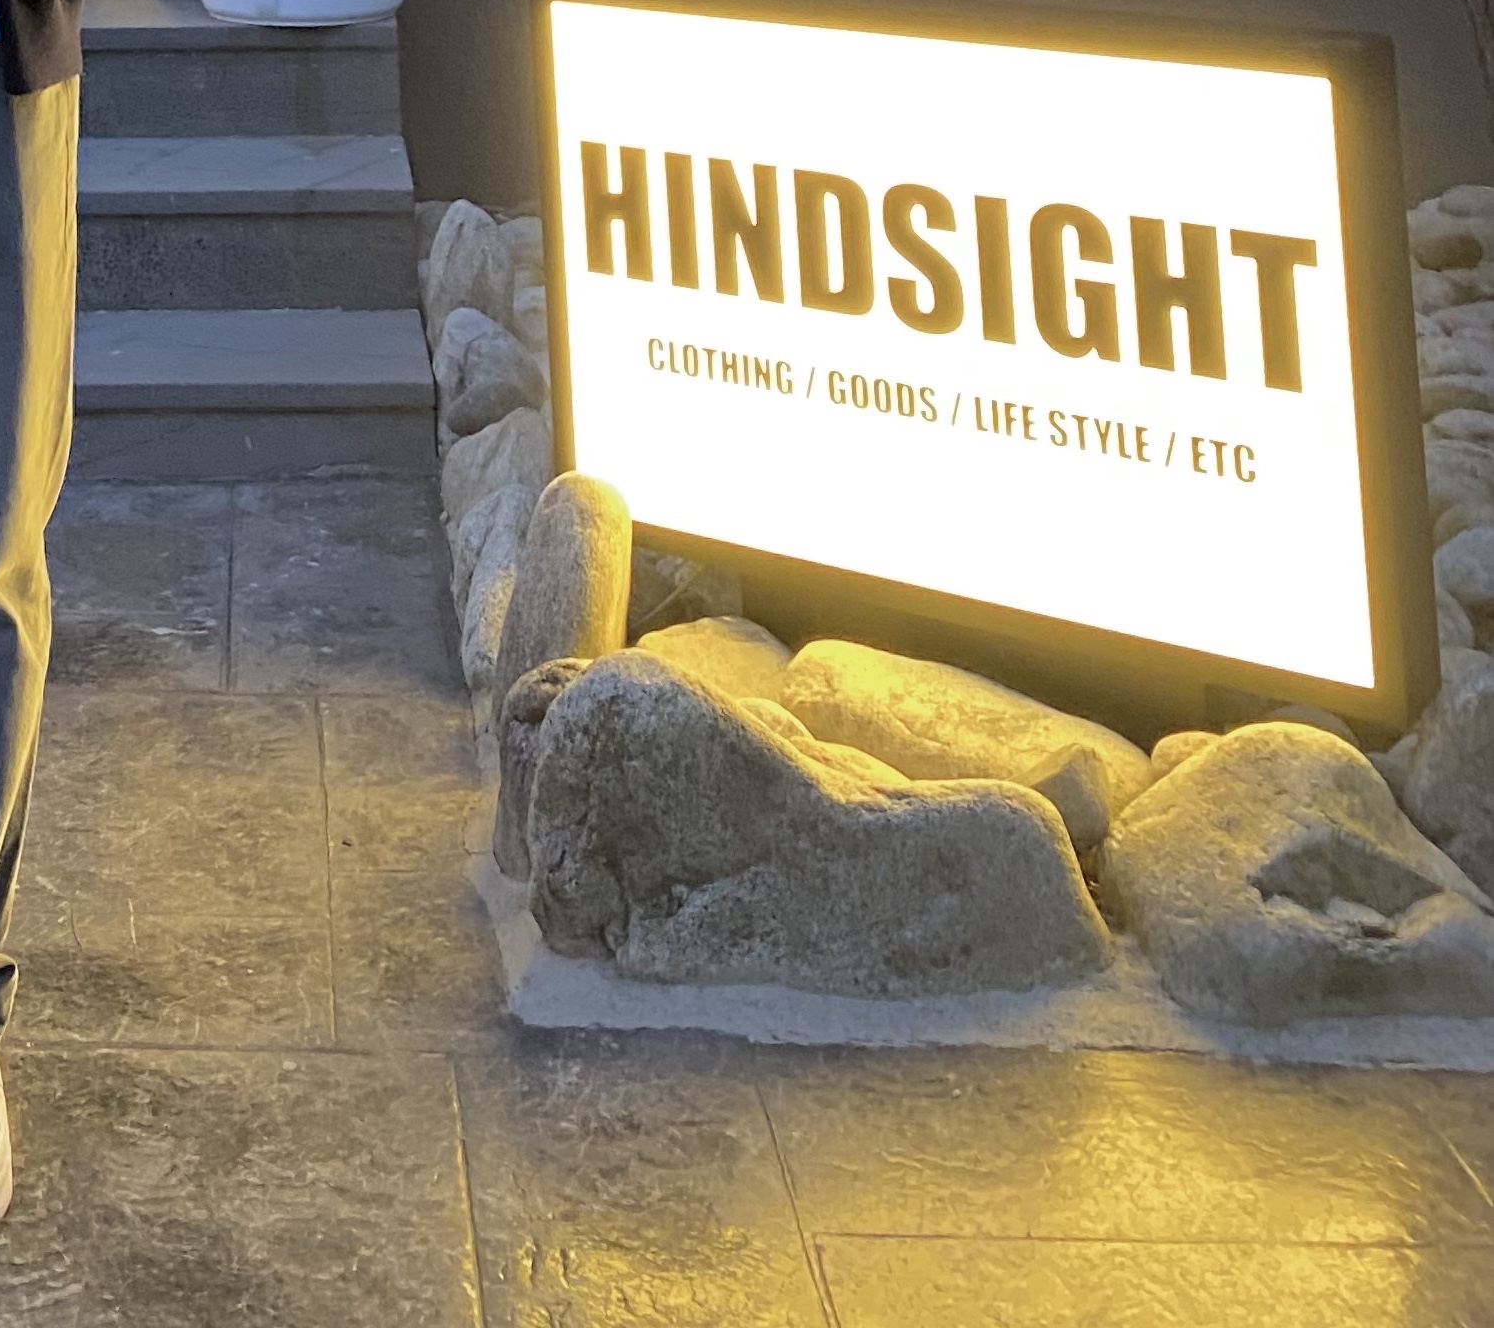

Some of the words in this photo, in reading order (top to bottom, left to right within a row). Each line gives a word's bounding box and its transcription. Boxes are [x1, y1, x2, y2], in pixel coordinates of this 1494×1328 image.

[579, 140, 1319, 394] HINDSIGHT
[648, 337, 794, 395] CLOTHING
[828, 370, 938, 423] GOODS
[974, 396, 1038, 441] LIFE
[1048, 410, 1152, 463] STYLE
[1190, 436, 1256, 483] ETC
